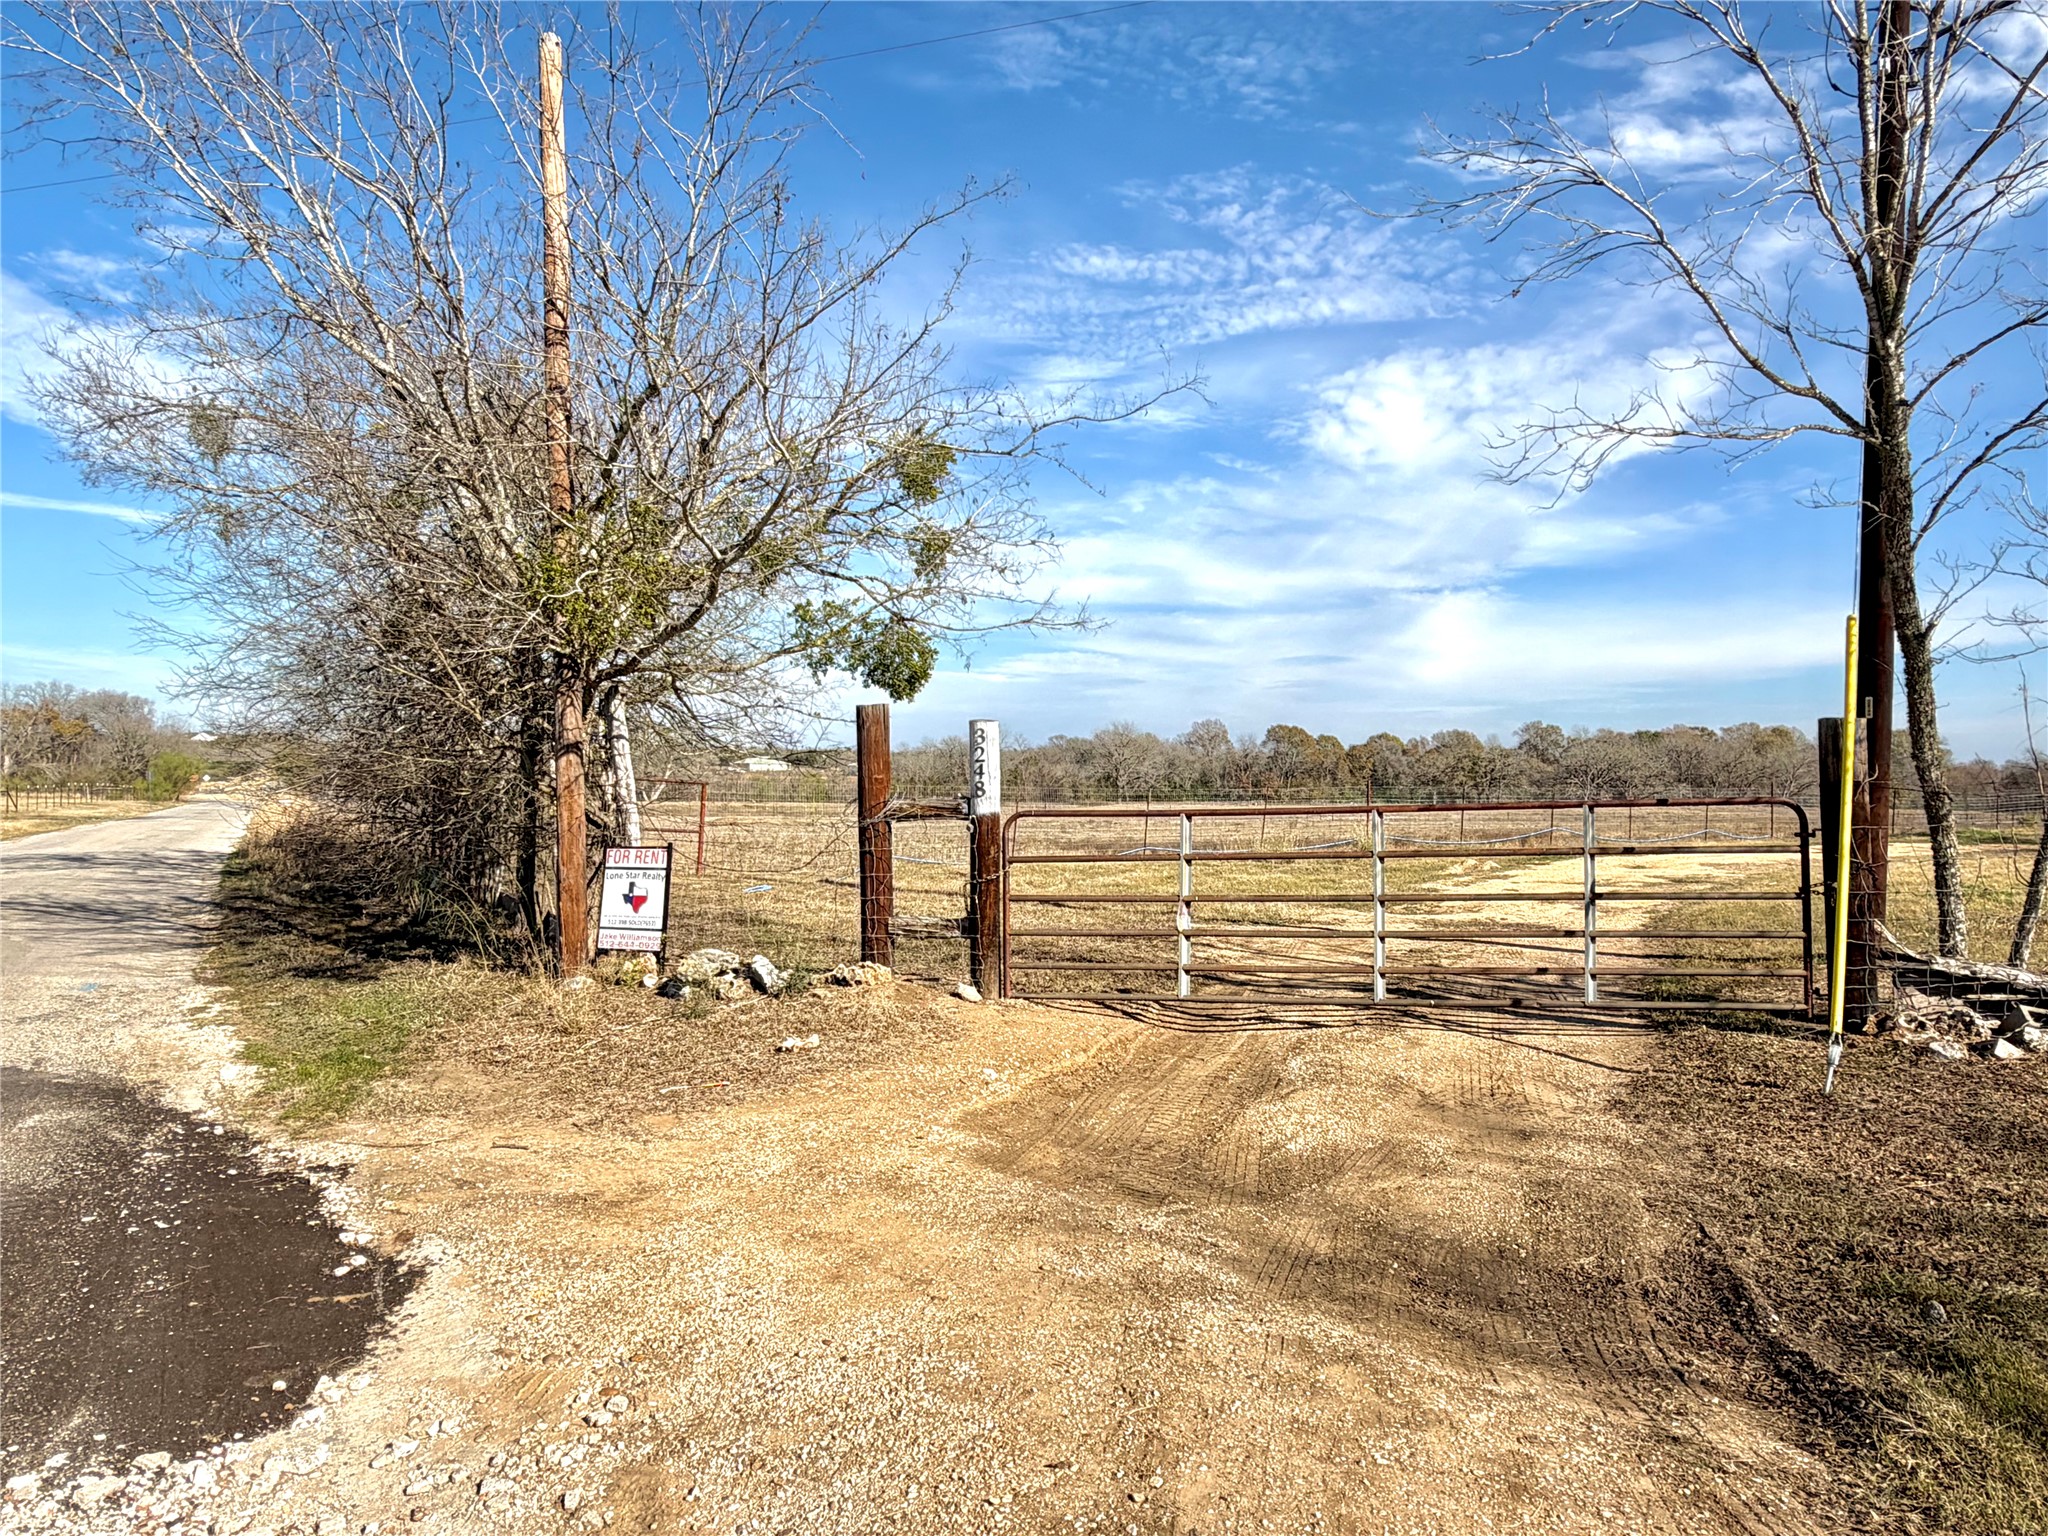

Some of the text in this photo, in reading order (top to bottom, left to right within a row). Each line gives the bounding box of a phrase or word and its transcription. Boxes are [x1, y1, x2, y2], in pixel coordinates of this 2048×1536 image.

[973, 728, 986, 798] 3248
[606, 849, 668, 865] FOR RENT
[606, 871, 666, 882] Lone Star Realty
[600, 932, 661, 942] Jake Williamson
